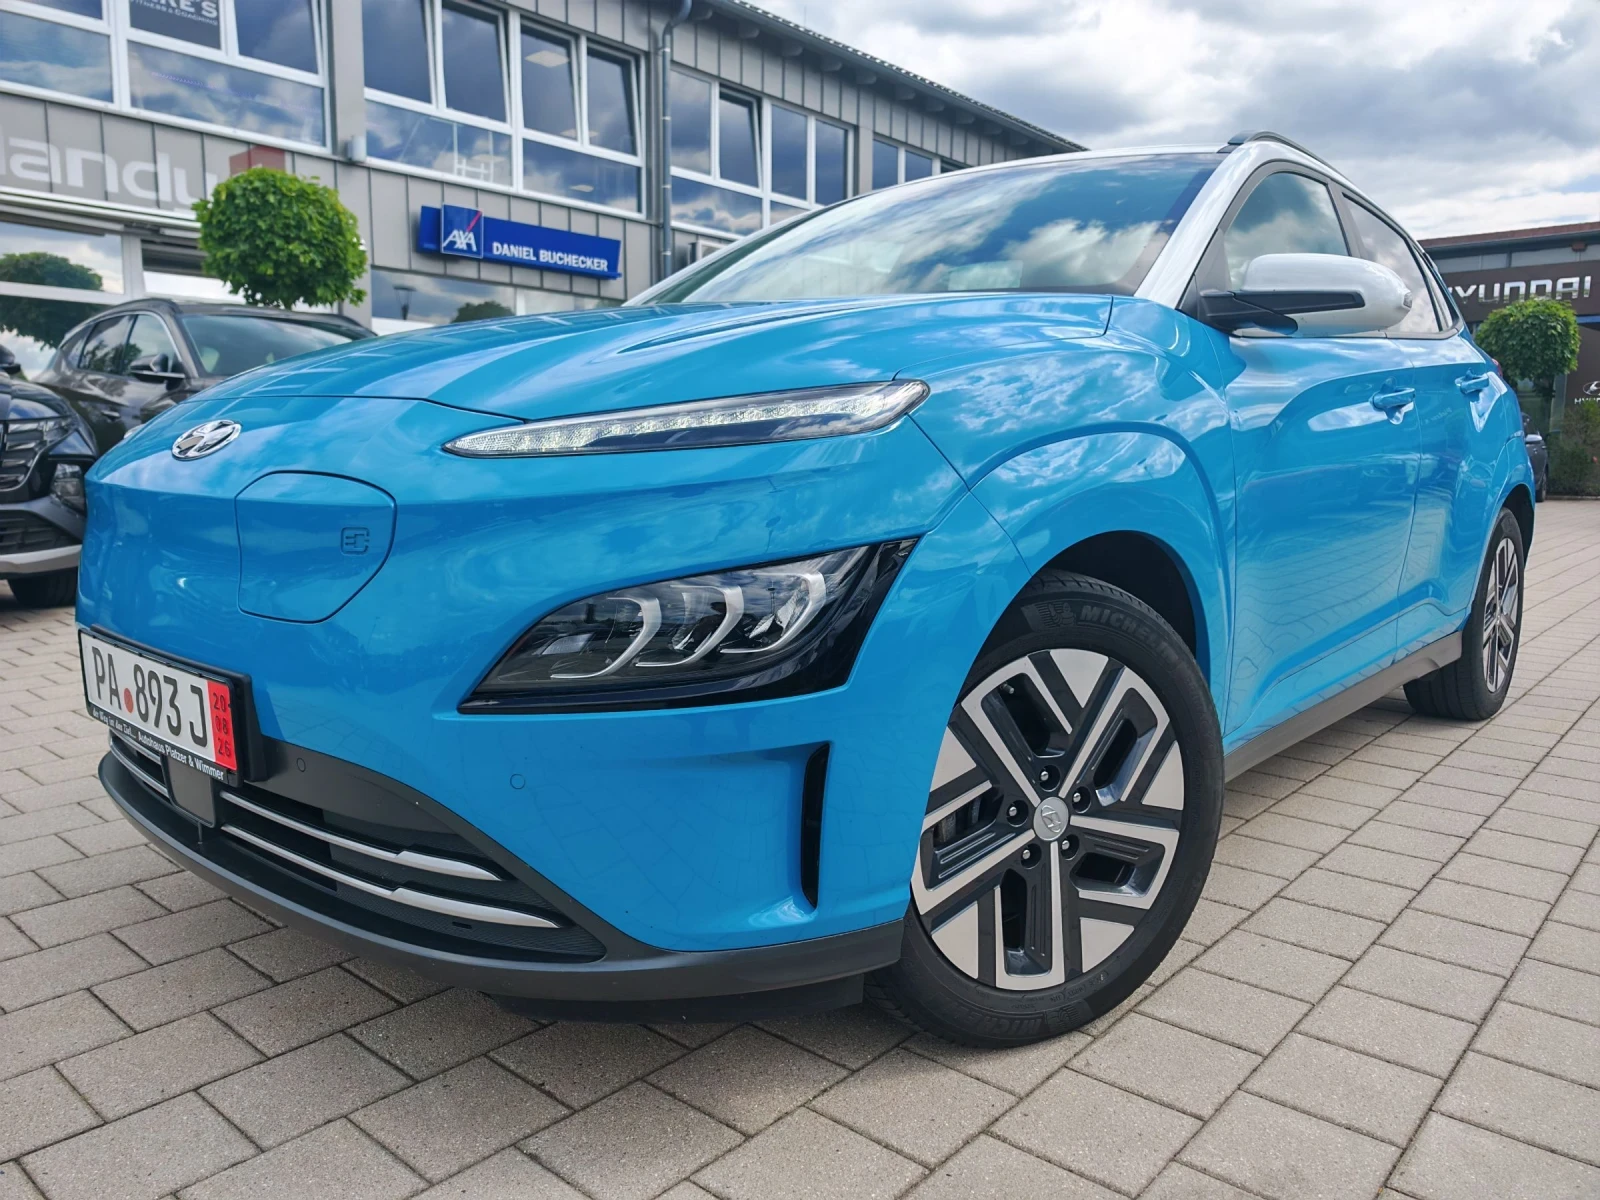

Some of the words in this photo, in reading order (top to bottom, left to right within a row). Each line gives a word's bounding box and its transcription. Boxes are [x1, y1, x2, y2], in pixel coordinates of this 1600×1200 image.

[0, 127, 218, 212] andy
[443, 229, 477, 252] AXA
[492, 241, 536, 261] DANIEL
[539, 249, 608, 272] BUCHECKER
[1448, 276, 1591, 304] YUNDAI
[92, 646, 122, 711] PA
[134, 664, 182, 737] 893
[189, 684, 208, 748] J
[213, 692, 226, 713] 20
[215, 715, 228, 735] 08
[138, 731, 165, 754] Autohaus
[165, 744, 187, 764] Platzer
[188, 755, 195, 767] &
[194, 758, 224, 780] Wimmer
[217, 738, 231, 758] 26
